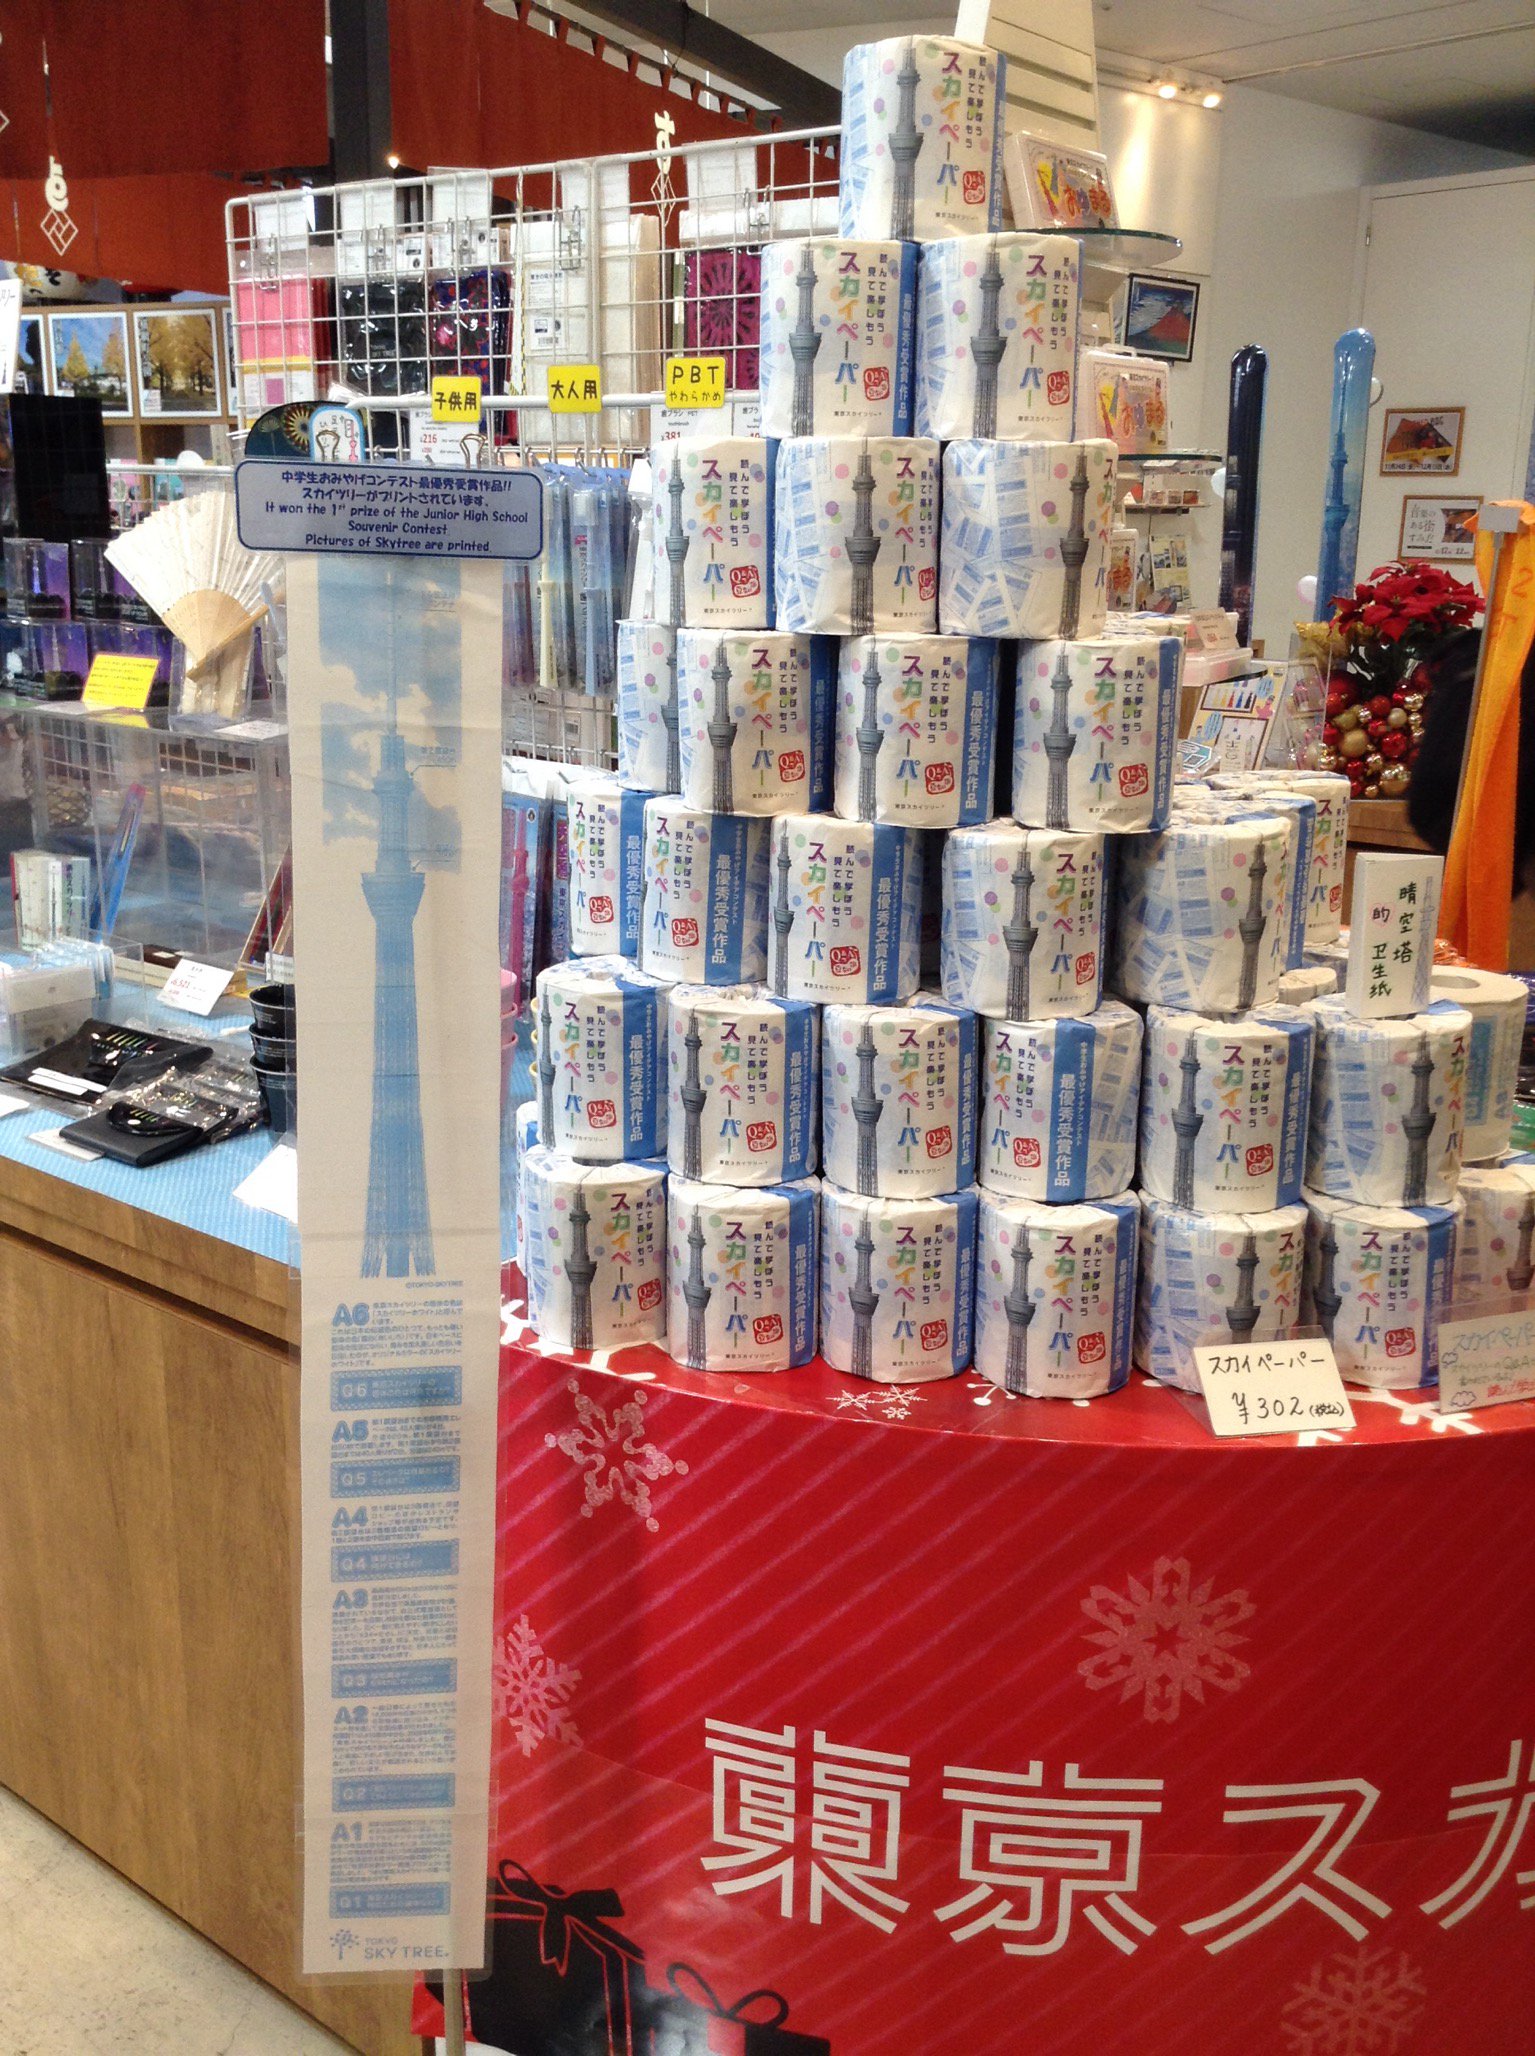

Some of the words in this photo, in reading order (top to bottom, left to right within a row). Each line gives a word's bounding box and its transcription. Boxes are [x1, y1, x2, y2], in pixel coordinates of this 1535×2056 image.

[936, 52, 962, 204] スカイペーパー
[835, 252, 860, 402] スカイペーパー
[1019, 255, 1047, 408] スカイペーパー
[434, 391, 477, 412] 子供用
[551, 379, 598, 400] 大人用
[669, 391, 721, 402] やわらかめ
[672, 366, 719, 384] PBT
[265, 501, 276, 513] It
[279, 504, 303, 514] won
[307, 502, 326, 515] the
[350, 505, 379, 520] prize
[383, 505, 396, 518] of
[400, 504, 419, 518] the
[423, 507, 459, 520] Junior
[463, 508, 488, 522] High
[493, 509, 528, 523] School
[305, 534, 354, 548] Pictures
[358, 534, 371, 548] of
[375, 536, 422, 551] Skytree
[425, 539, 444, 550] are
[348, 520, 398, 534] Souvenir
[402, 522, 448, 535] Contest
[701, 459, 725, 602] スカイペーパー
[894, 457, 915, 606] スカイペーパー
[751, 649, 774, 786] スカイペーパー
[895, 656, 924, 797] スカイペーパー
[927, 669, 939, 744] 見て楽しもう
[940, 656, 951, 732] 読んで学ぼう
[1089, 656, 1118, 801] スカイペーパー
[1120, 669, 1134, 746] 見て楽しもう
[1133, 656, 1145, 733] 読んで学ぼう
[964, 690, 985, 809] 最優秀受賞作品
[576, 801, 586, 928] スカイペーパー
[625, 835, 643, 939] 最優秀受賞作品
[653, 816, 670, 946] スカイペーパー
[673, 831, 683, 900] 見て楽しもう
[683, 820, 695, 889] 読んで学ぼう
[831, 856, 842, 928] 見て楽しもう
[844, 844, 855, 917] 読んで学ぼう
[1310, 799, 1333, 917] スカイペーパー
[711, 854, 731, 964] 最優秀受賞作品
[805, 842, 827, 978] スカイペーパー
[872, 876, 892, 991] 最優秀受賞作品
[1050, 853, 1077, 990] スカイペーパー
[1392, 882, 1417, 963] 晴空塔
[564, 1002, 582, 1128] スカイペーパー
[586, 1016, 595, 1083] 見て楽しもう
[596, 1005, 606, 1072] 読んで学ぼう
[759, 1023, 768, 1093] 読んで学ぼう
[1015, 1048, 1025, 1119] 見て楽しもう
[1026, 1038, 1037, 1109] 読んで学ぼう
[629, 1034, 644, 1141] 最優秀受賞作品
[719, 1021, 742, 1154] スカイペーパー
[897, 1028, 921, 1163] スカイペーパー
[991, 1031, 1012, 1165] スカイペーパー
[1054, 1073, 1075, 1187] 最優秀受賞作品
[1216, 1045, 1245, 1179] スカイペーパー
[610, 1193, 634, 1318] スカイペーパー
[725, 1221, 749, 1348] スカイペーパー
[892, 1226, 917, 1356] スカイペーパー
[1049, 1235, 1076, 1368] スカイペーパー
[1355, 1231, 1383, 1359] スカイペーパー
[332, 1302, 370, 1327] A6
[1208, 1351, 1325, 1375] スカイペーパー
[1232, 1392, 1304, 1424] ¥302
[332, 1419, 369, 1443] A5
[332, 1505, 368, 1529] A4
[333, 1588, 369, 1610] A3
[333, 1705, 369, 1725] A2
[332, 1821, 363, 1842] A1
